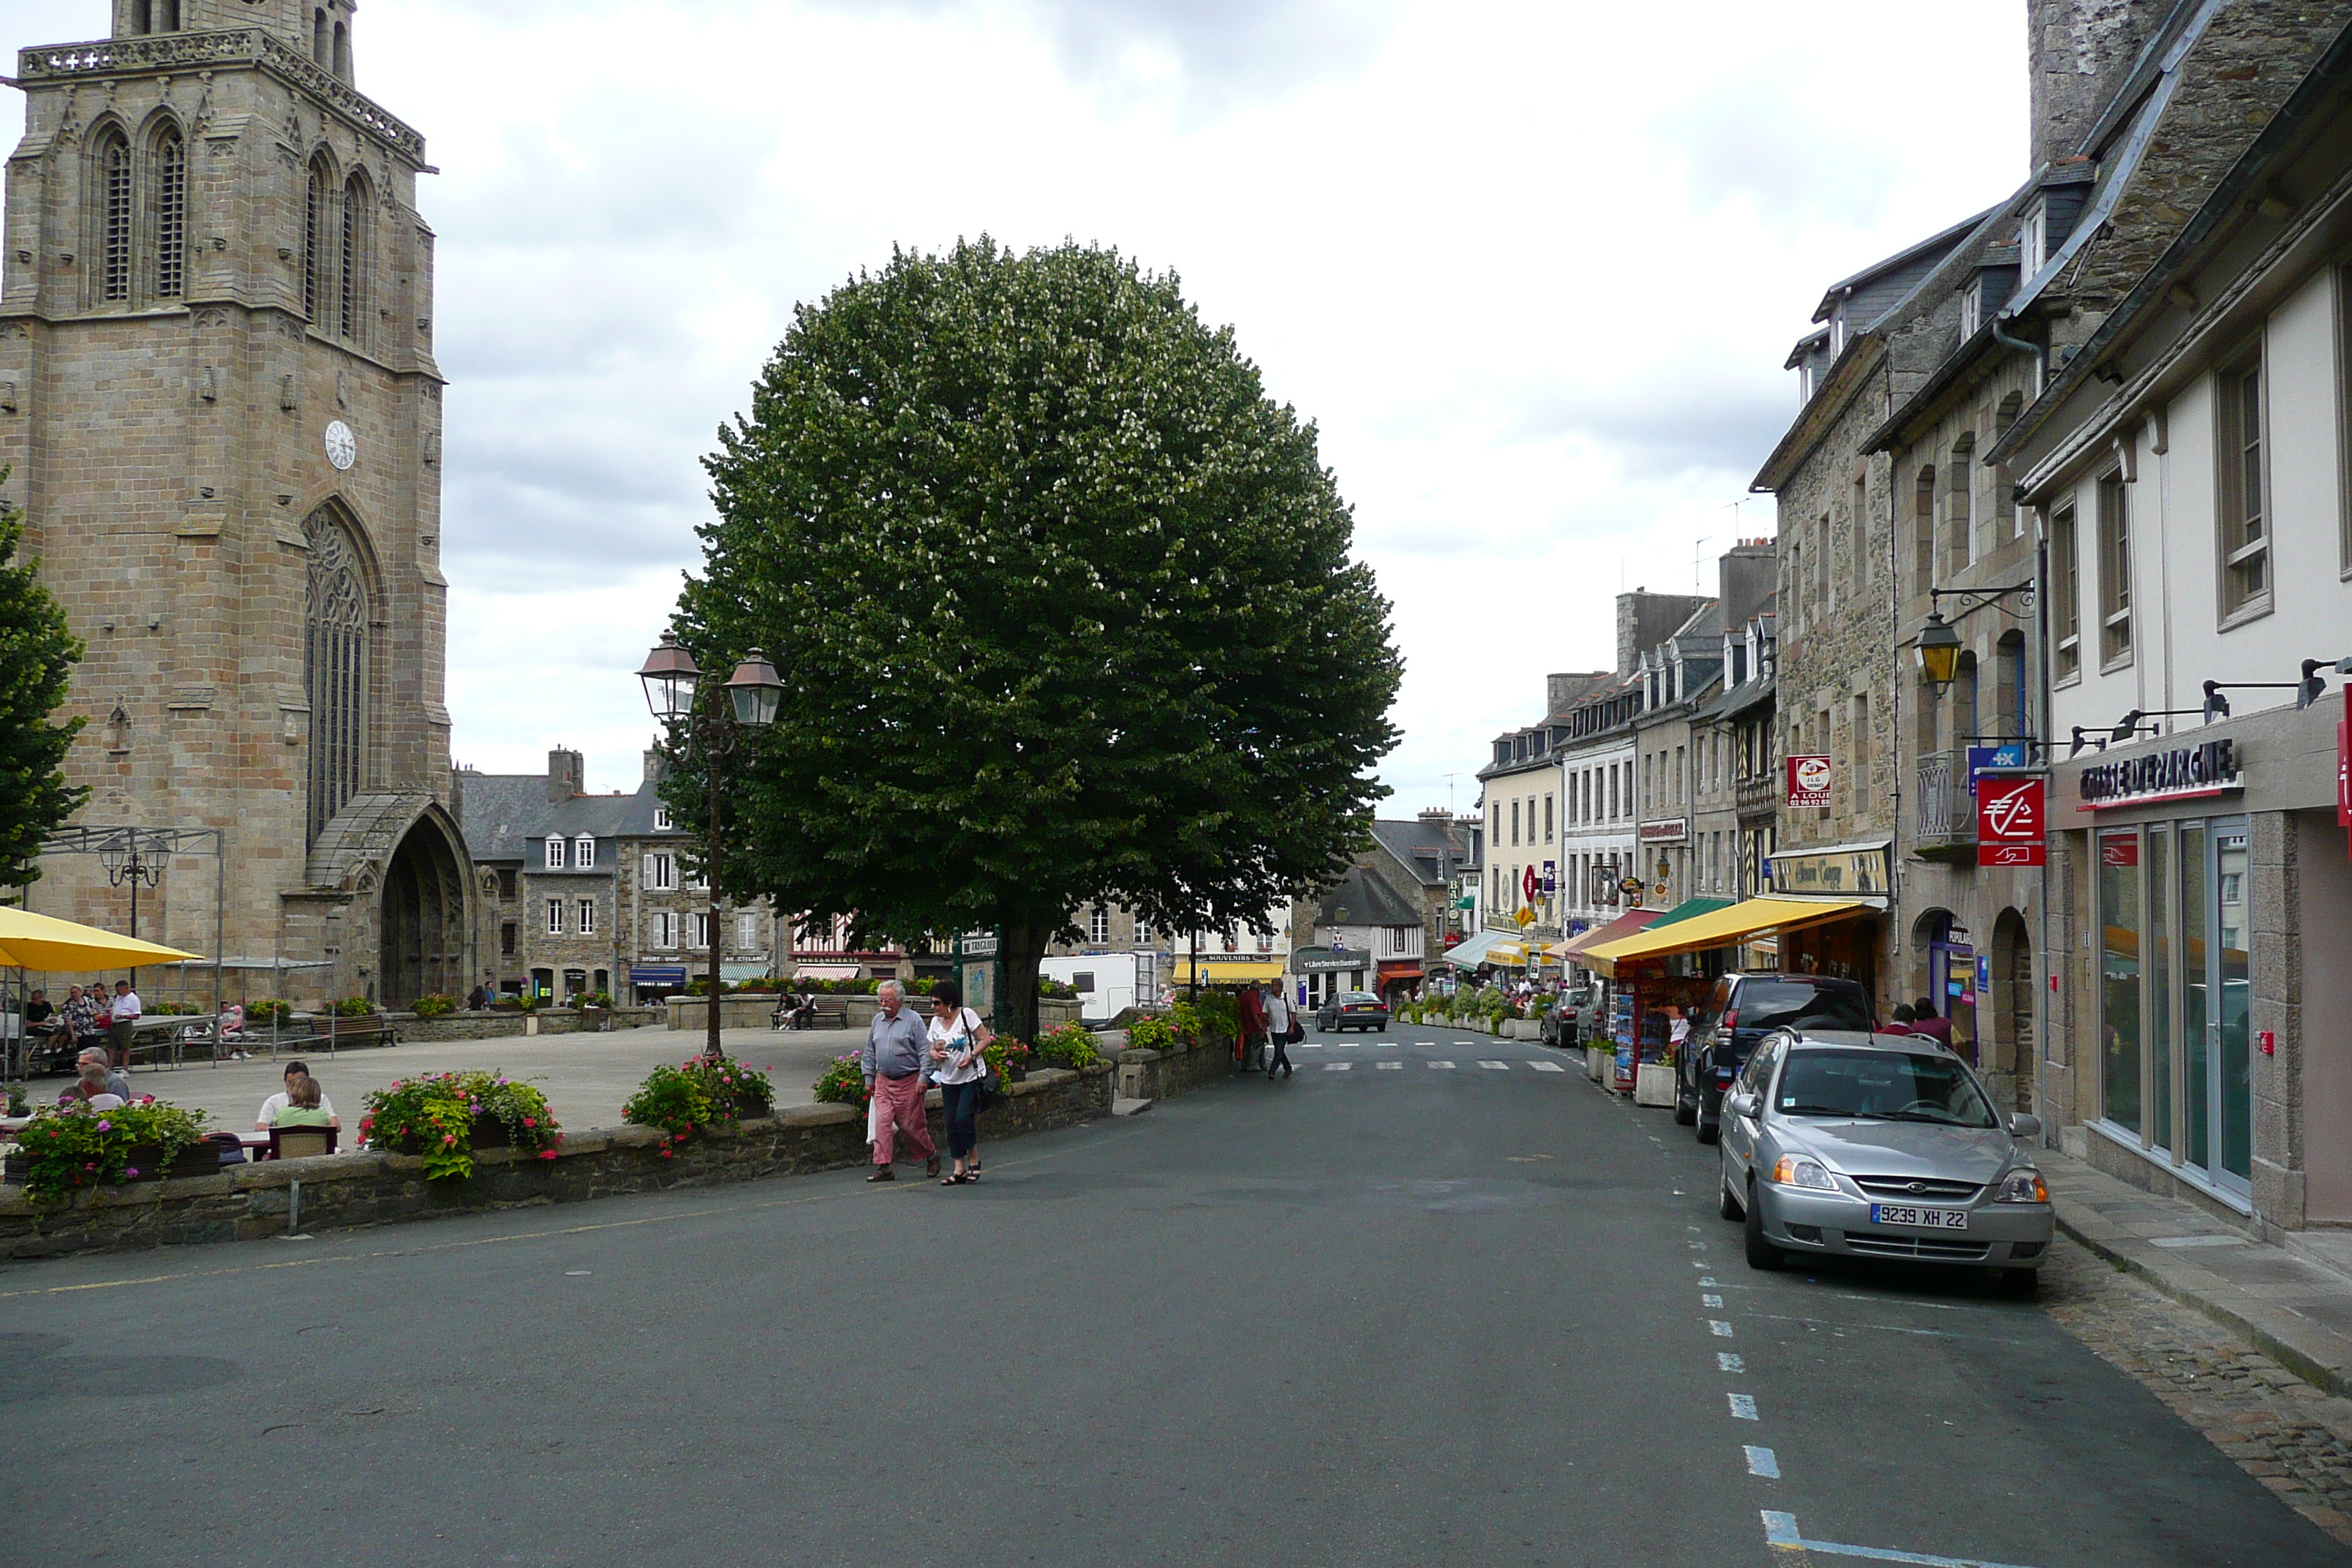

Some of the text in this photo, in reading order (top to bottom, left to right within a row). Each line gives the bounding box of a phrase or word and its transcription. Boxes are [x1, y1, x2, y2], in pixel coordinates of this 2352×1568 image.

[2080, 760, 2131, 801] CAISSE
[1882, 1207, 1964, 1227] 9239 XH 22
